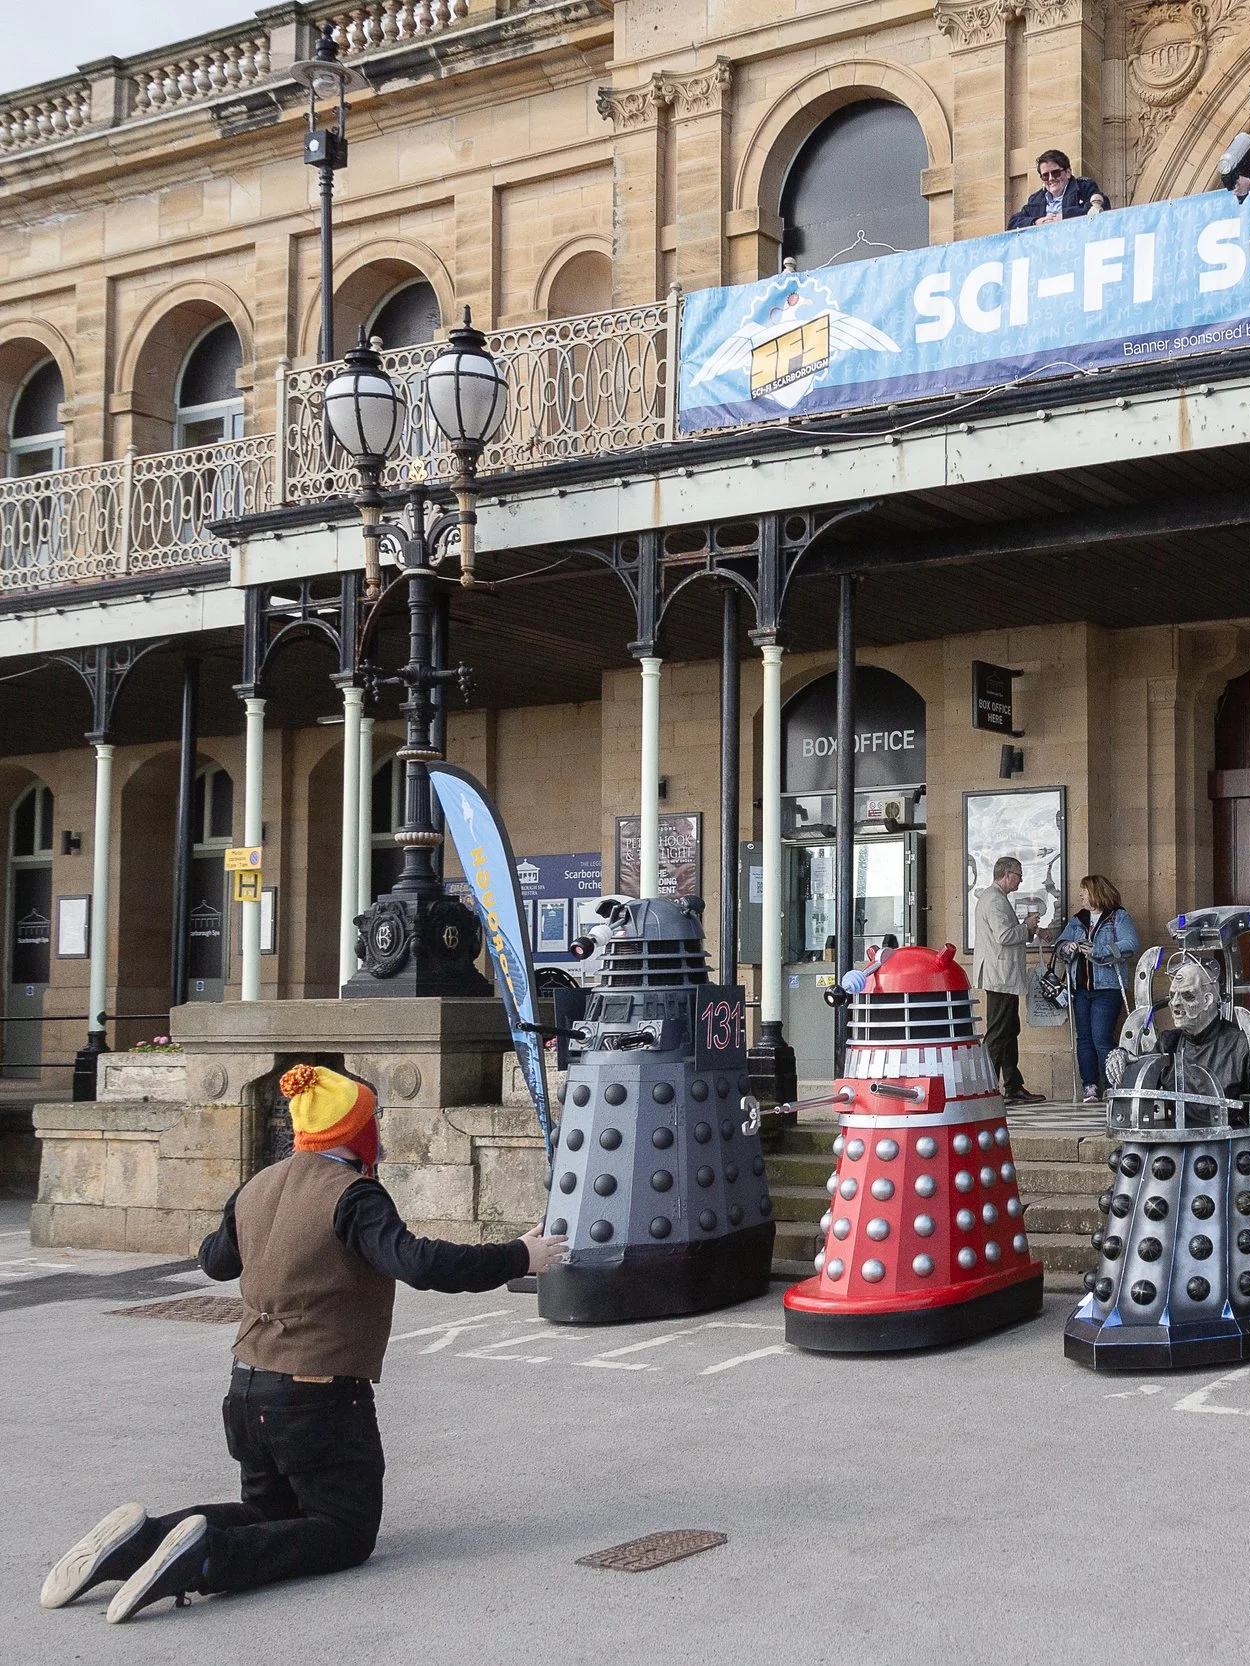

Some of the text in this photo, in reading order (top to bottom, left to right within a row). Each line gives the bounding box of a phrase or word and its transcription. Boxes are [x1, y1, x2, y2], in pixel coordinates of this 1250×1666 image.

[914, 233, 1155, 344] SCI-FI
[1123, 339, 1170, 357] Banner
[1173, 327, 1243, 350] sponsored
[752, 359, 828, 399] SCI-FI SCARBOROUGH
[979, 698, 1011, 715] BOX OFFICE
[987, 713, 1003, 725] HERE
[802, 737, 837, 757] BOX
[659, 835, 692, 847] HOOK
[661, 847, 692, 859] LIGHT
[564, 869, 602, 879] Scarboro
[238, 873, 258, 898] H
[578, 880, 602, 890] Orche
[701, 1000, 741, 1050] 131
